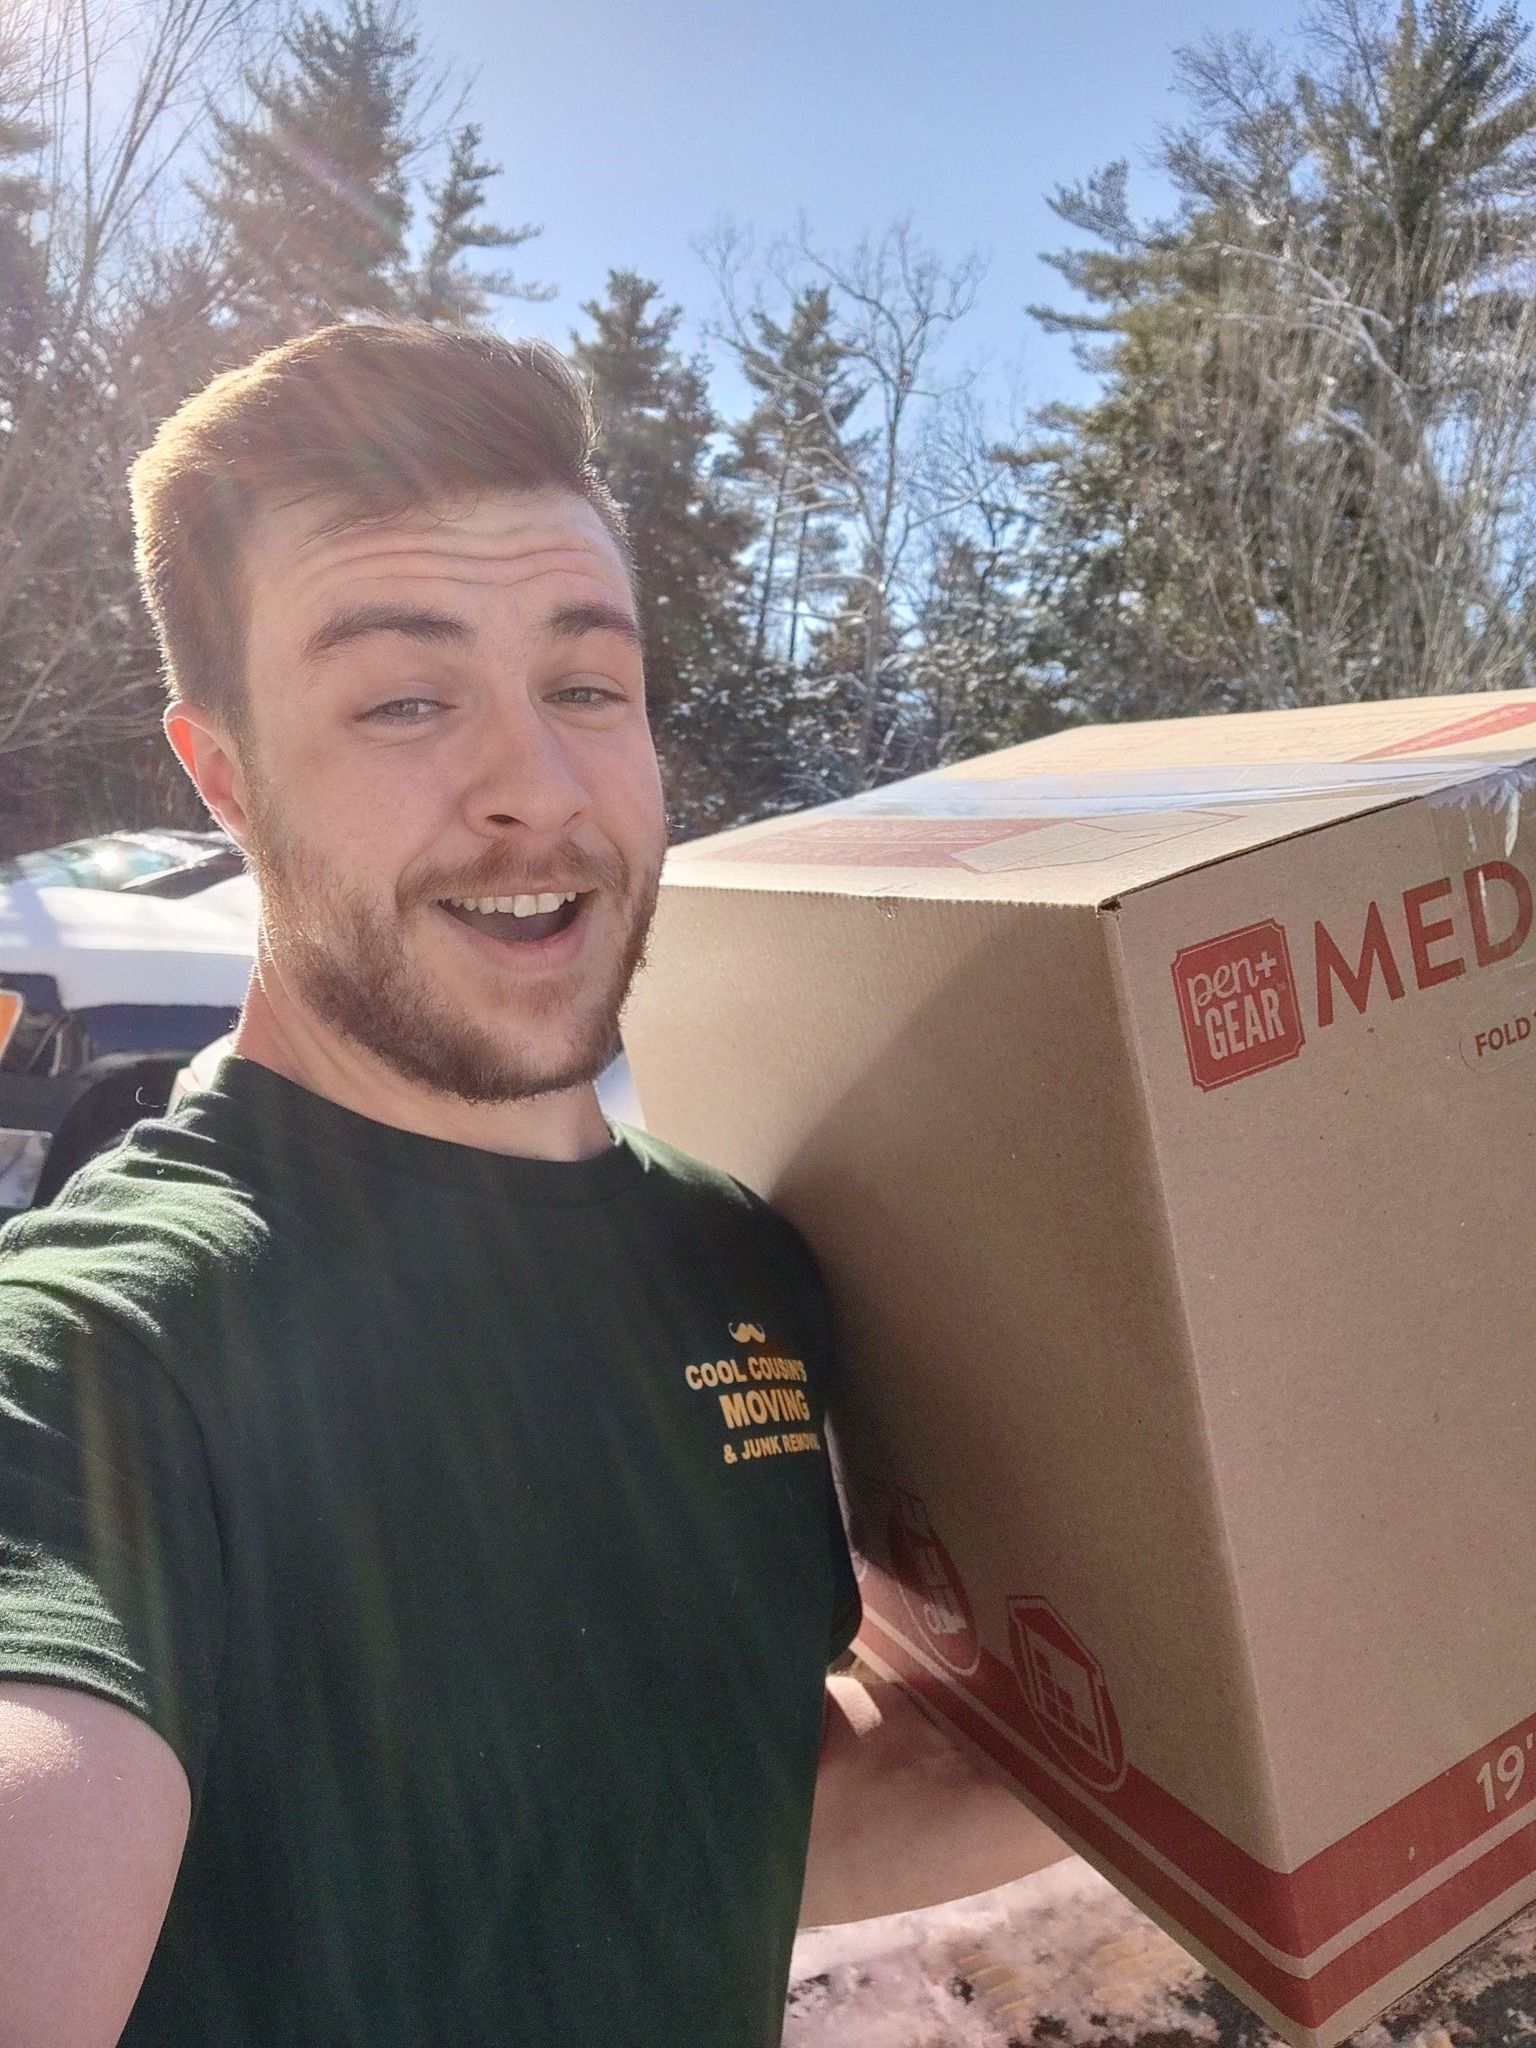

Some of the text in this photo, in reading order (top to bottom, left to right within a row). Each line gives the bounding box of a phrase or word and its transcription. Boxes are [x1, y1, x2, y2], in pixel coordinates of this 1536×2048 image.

[1314, 860, 1534, 1028] MED
[1187, 951, 1278, 1027] pen+
[1205, 987, 1286, 1061] GEAR
[685, 1359, 747, 1390] COOL
[719, 1389, 810, 1429] MOVING
[723, 1443, 738, 1465] &
[742, 1436, 782, 1460] JUNK
